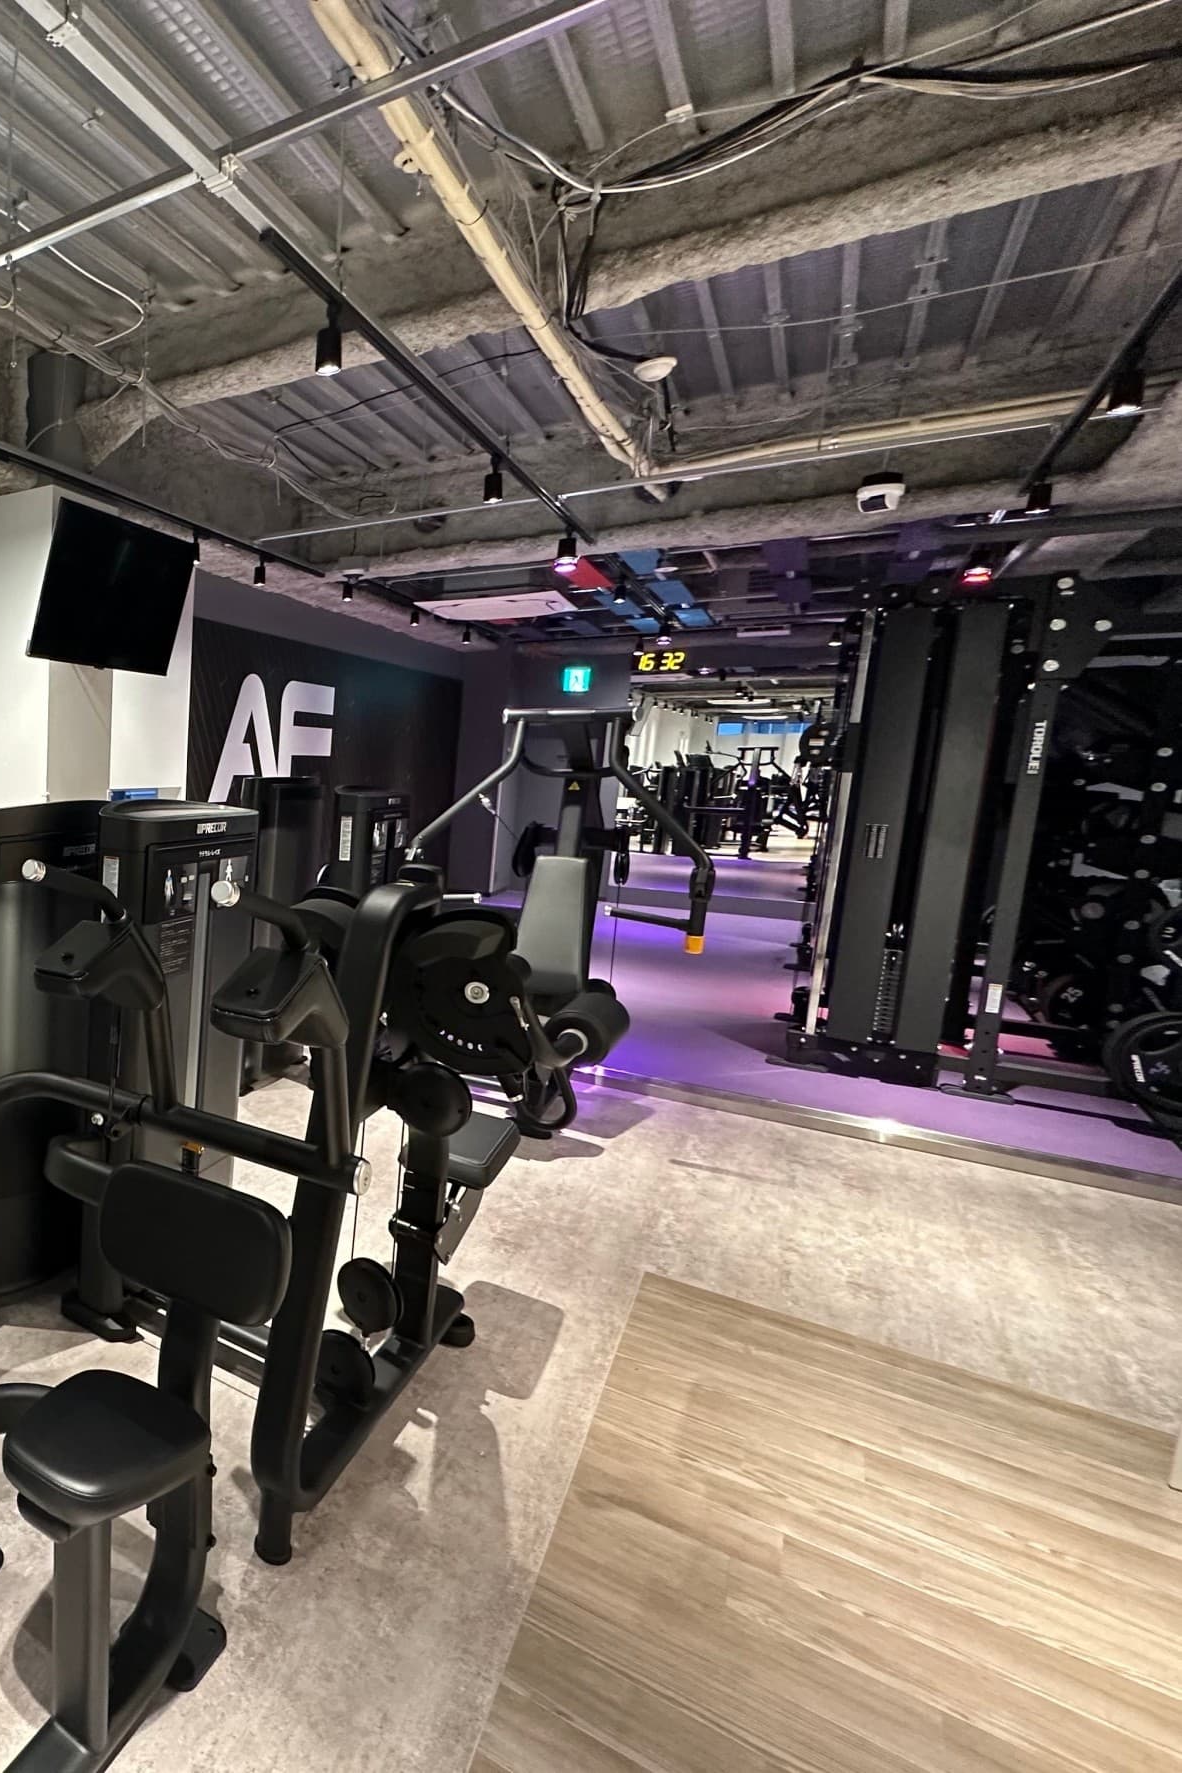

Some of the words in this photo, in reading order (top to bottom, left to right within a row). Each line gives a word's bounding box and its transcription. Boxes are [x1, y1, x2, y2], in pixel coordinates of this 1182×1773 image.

[638, 653, 656, 671] 16
[659, 651, 685, 671] 32
[207, 673, 336, 803] AF
